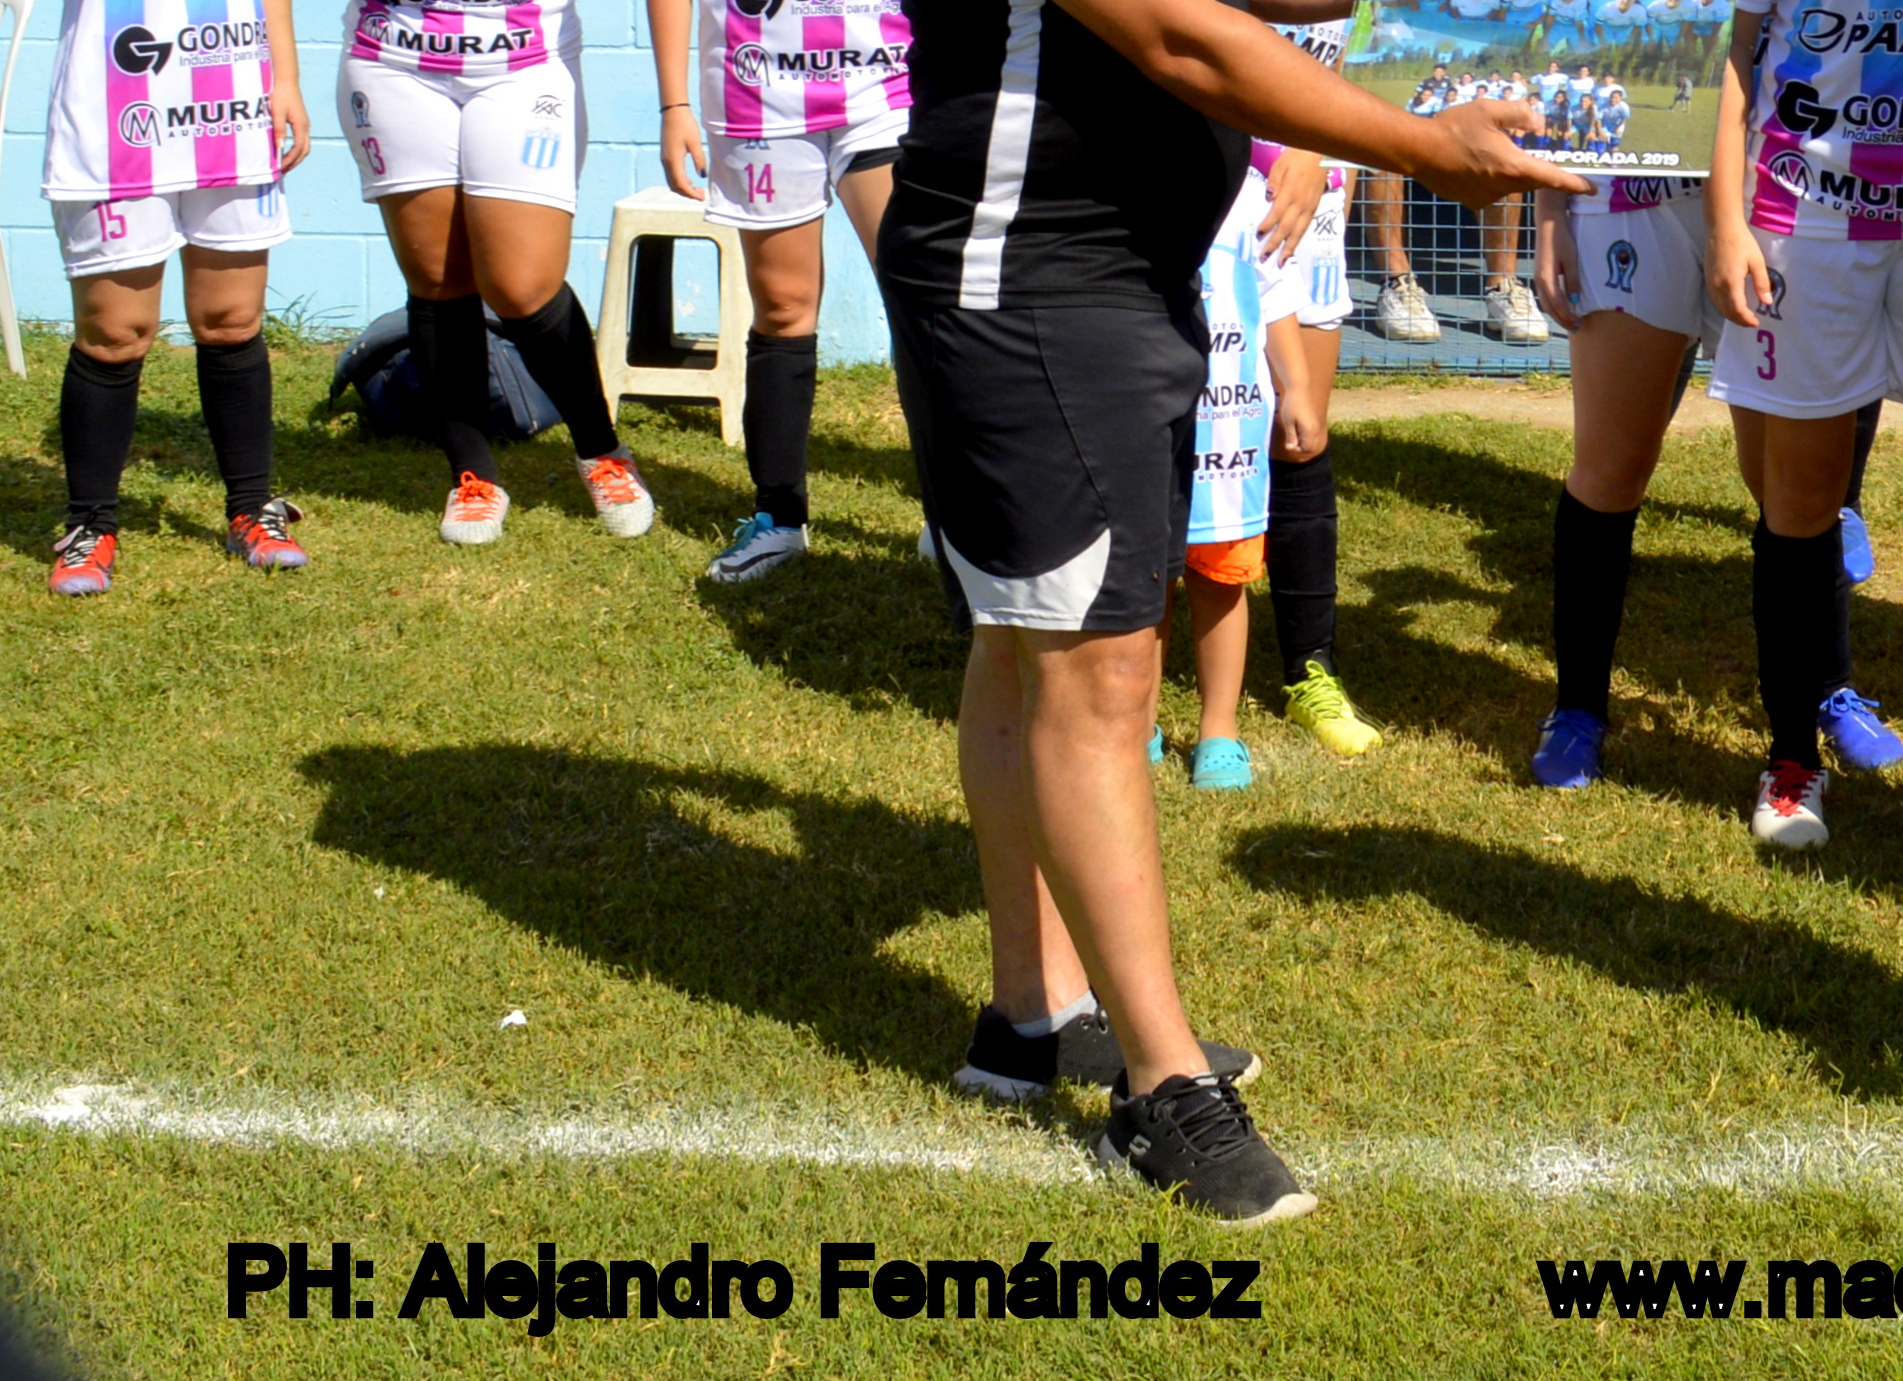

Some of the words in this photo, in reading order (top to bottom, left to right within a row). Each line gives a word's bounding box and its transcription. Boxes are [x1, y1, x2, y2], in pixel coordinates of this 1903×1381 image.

[791, 3, 843, 15] Industria
[846, 3, 870, 16] para
[397, 29, 534, 55] MURAT
[777, 44, 908, 72] MURAT
[361, 137, 386, 176] 13
[1641, 152, 1680, 167] 2019
[744, 163, 776, 204] 14
[94, 199, 128, 243] 15
[1757, 330, 1778, 381] 3
